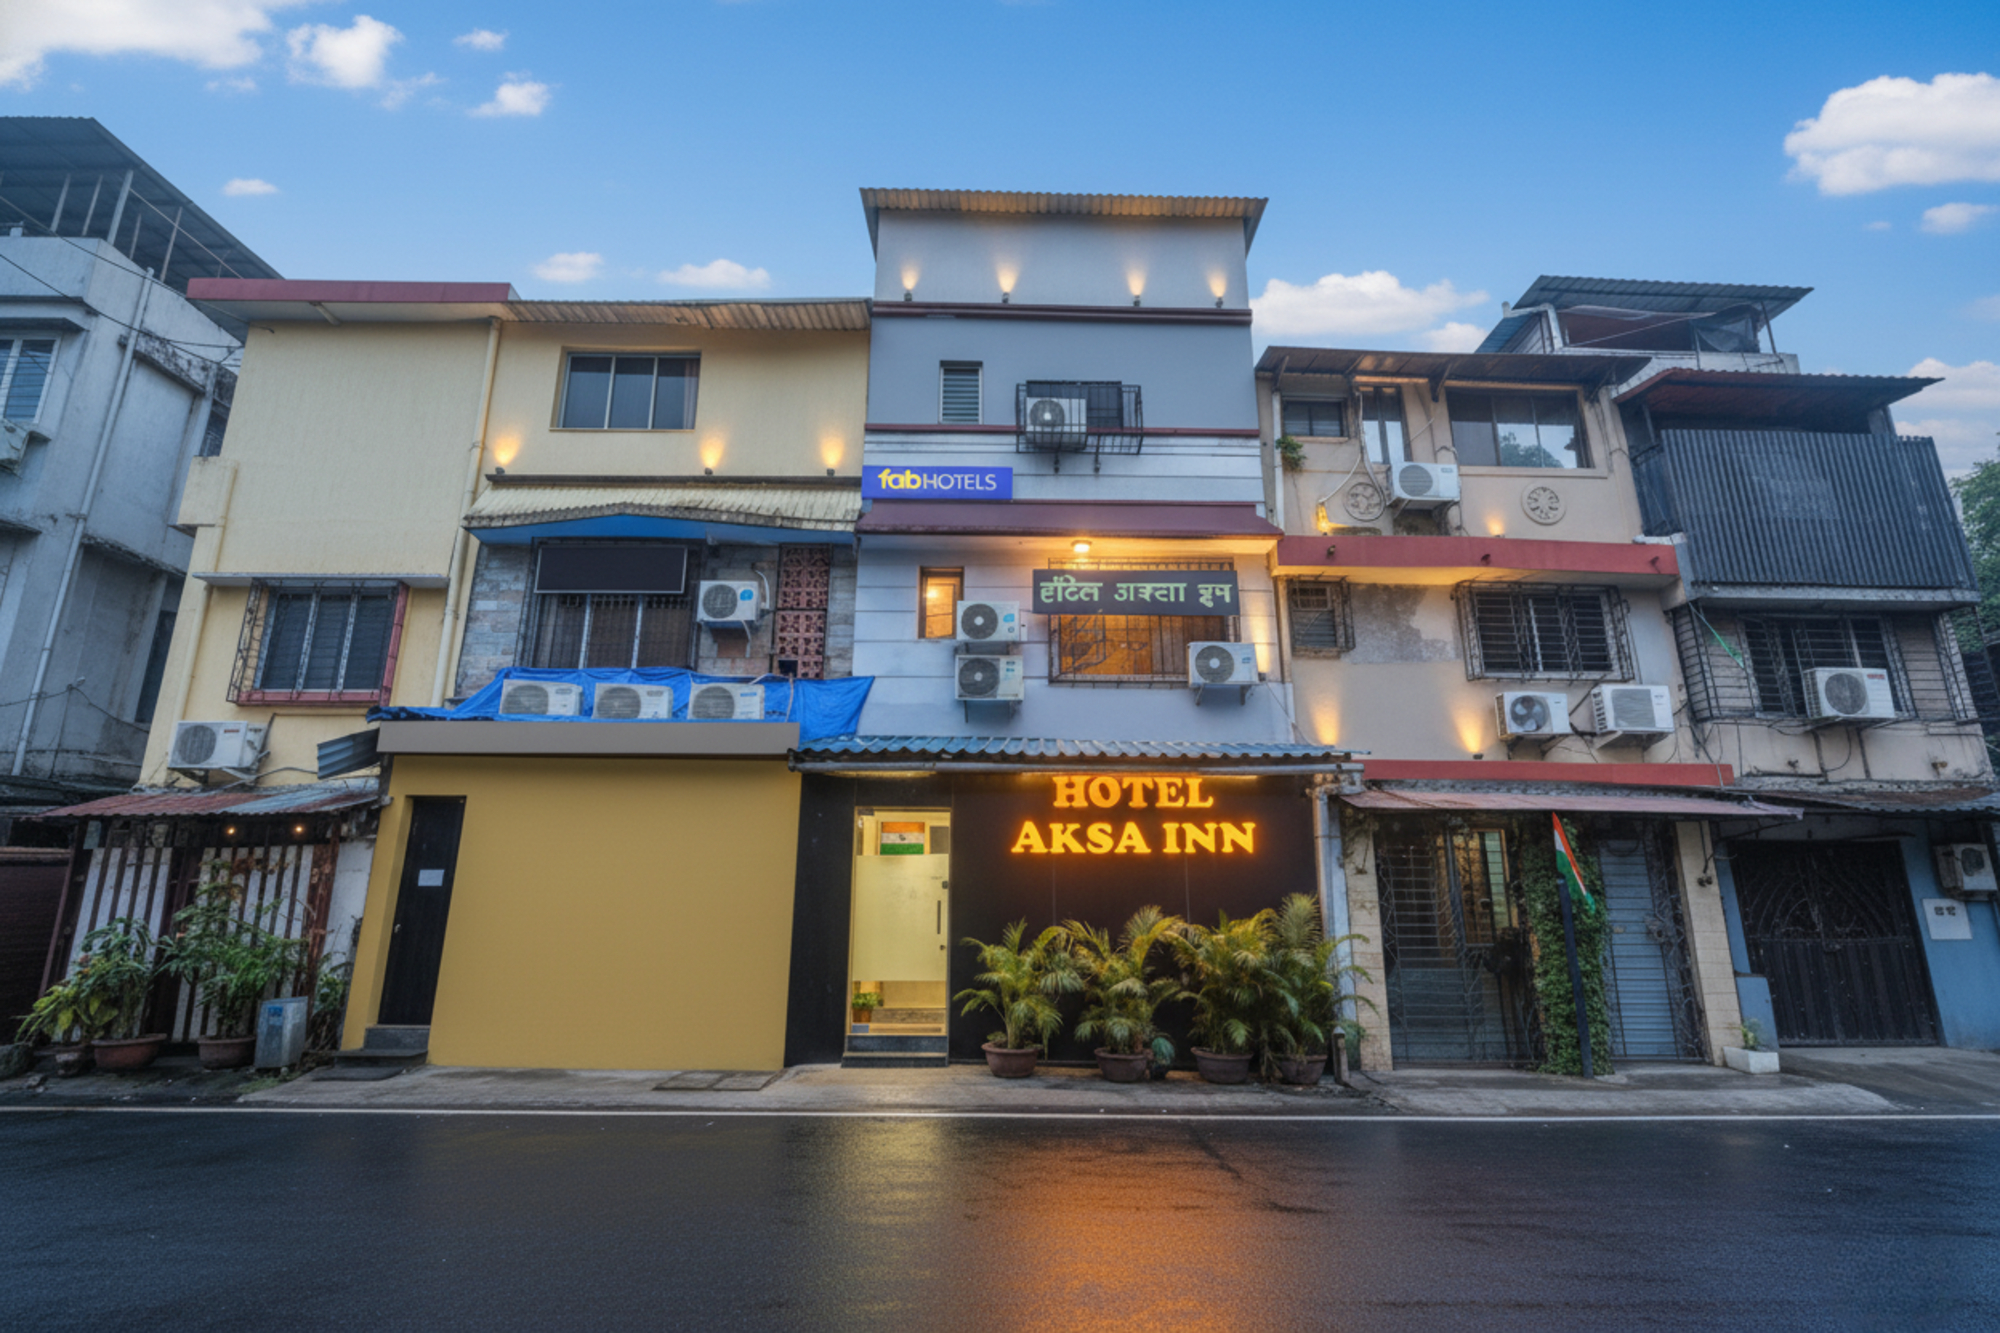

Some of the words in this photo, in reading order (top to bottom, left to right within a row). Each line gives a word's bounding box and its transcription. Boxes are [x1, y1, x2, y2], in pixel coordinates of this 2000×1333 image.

[1052, 775, 1214, 808] HOTEL
[1010, 820, 1152, 854] AKSA
[1162, 821, 1256, 854] INN
